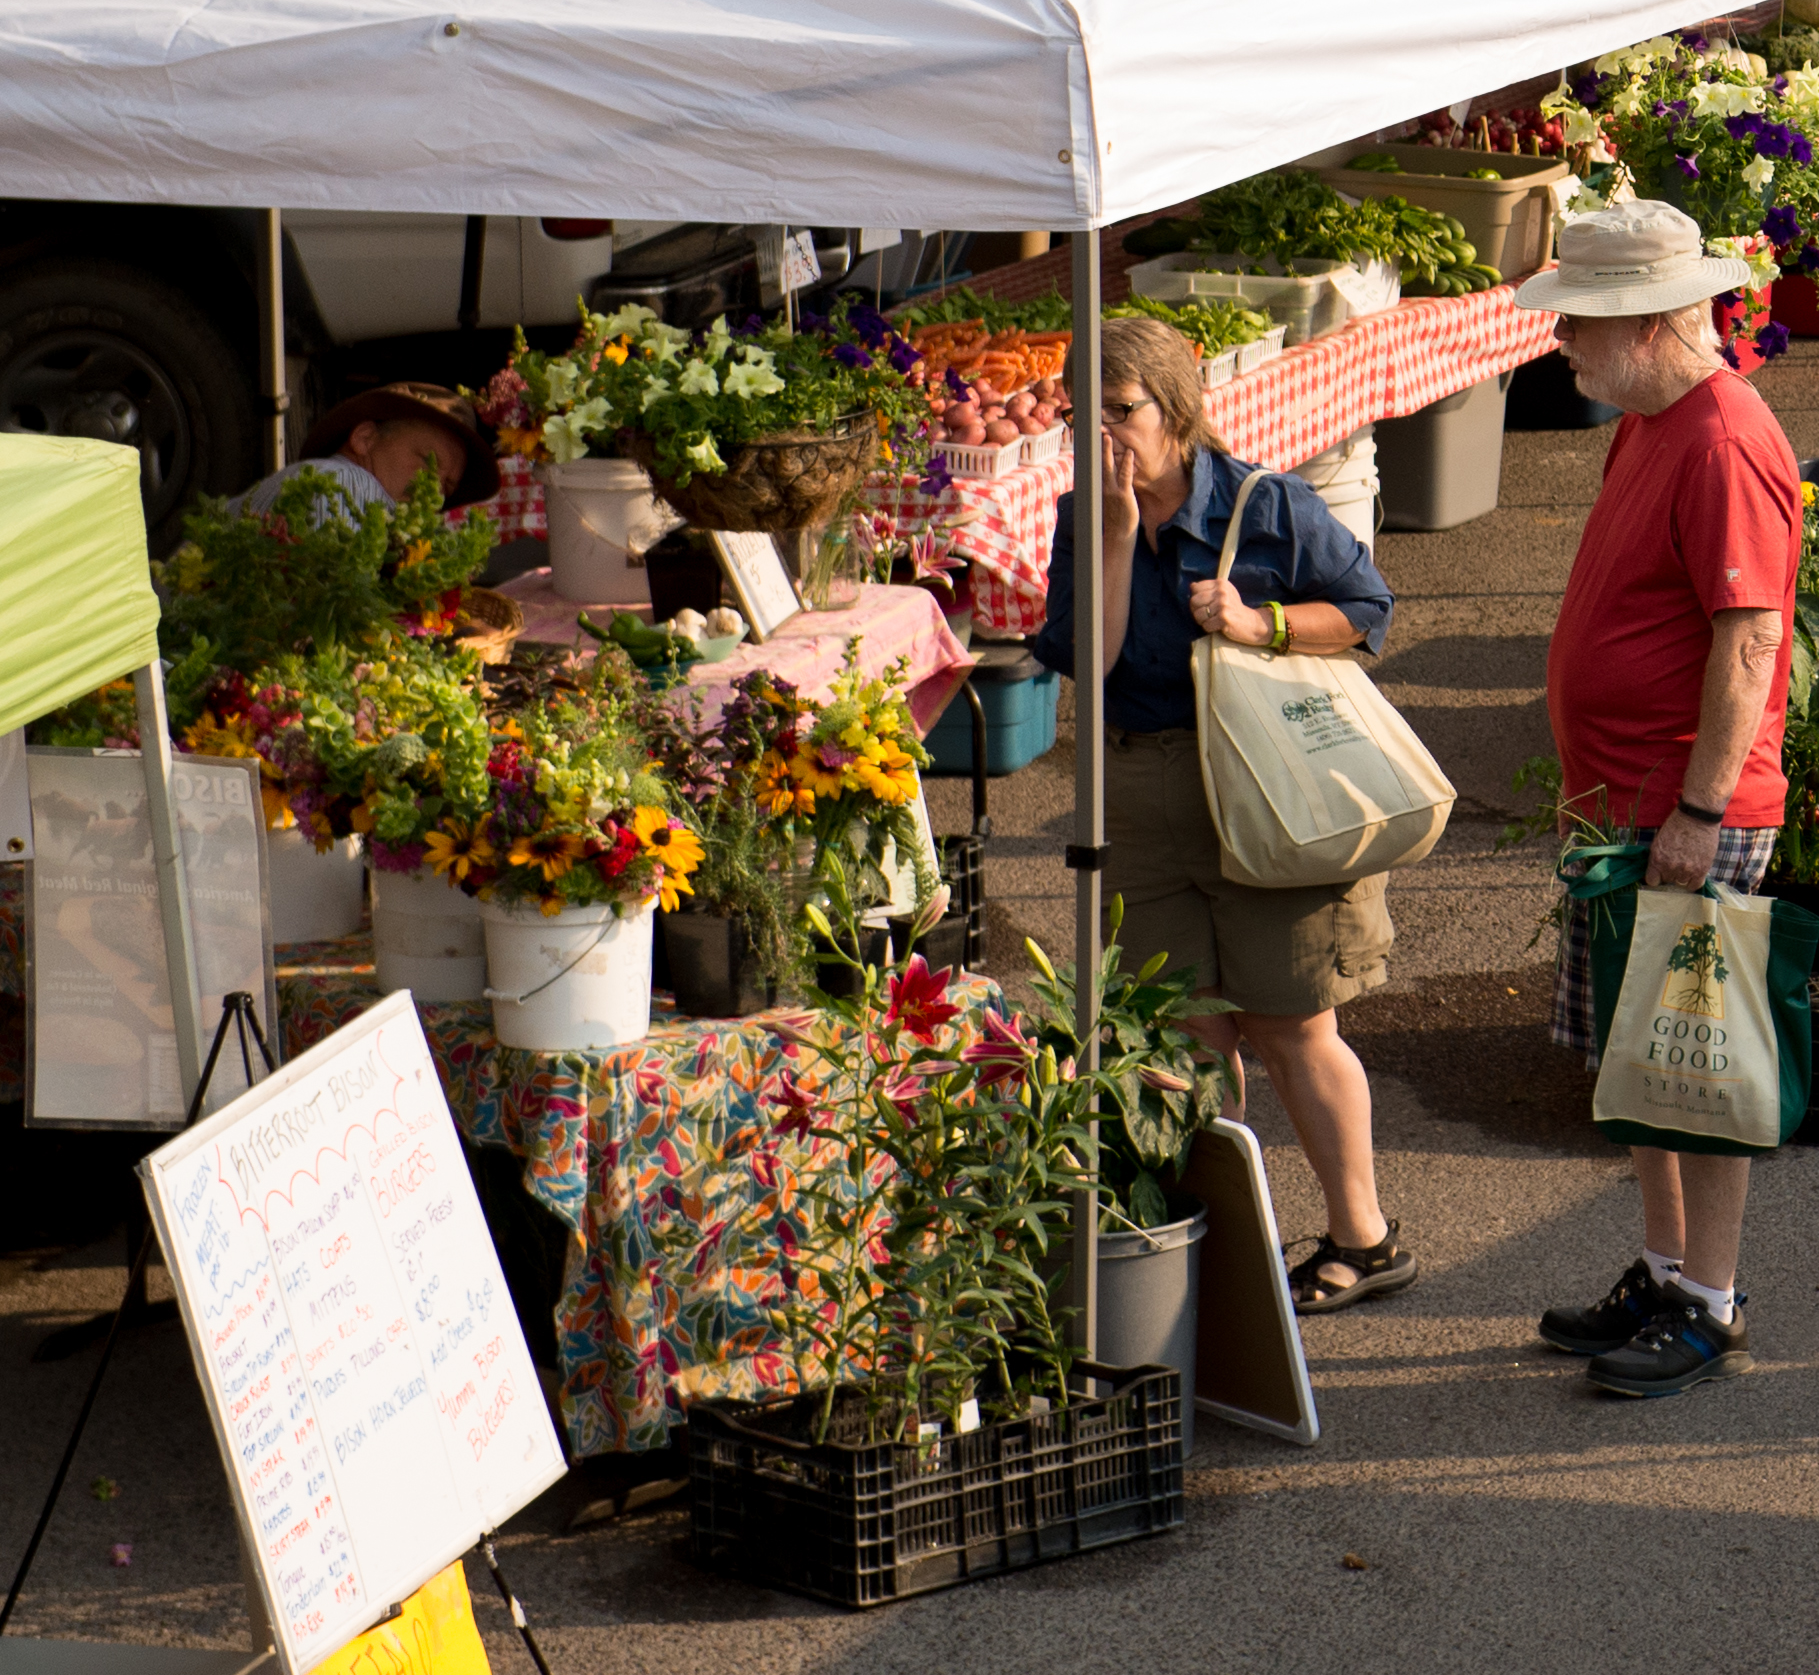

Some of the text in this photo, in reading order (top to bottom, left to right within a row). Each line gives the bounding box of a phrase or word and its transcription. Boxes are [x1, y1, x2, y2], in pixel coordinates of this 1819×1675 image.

[1648, 1041, 1728, 1072] FOOD
[1653, 1015, 1727, 1046] GOOD
[1644, 1076, 1727, 1100] STORE
[229, 1049, 380, 1201] BITTERROOT BISON
[173, 1154, 213, 1237] FROZEN
[370, 1142, 436, 1219] BURGERS
[424, 1190, 454, 1228] FRESH
[283, 1232, 352, 1303] HATS COATS
[308, 1274, 358, 1327] MITTENS
[437, 1335, 507, 1432] Yummy Bison
[334, 1418, 368, 1467] BISON
